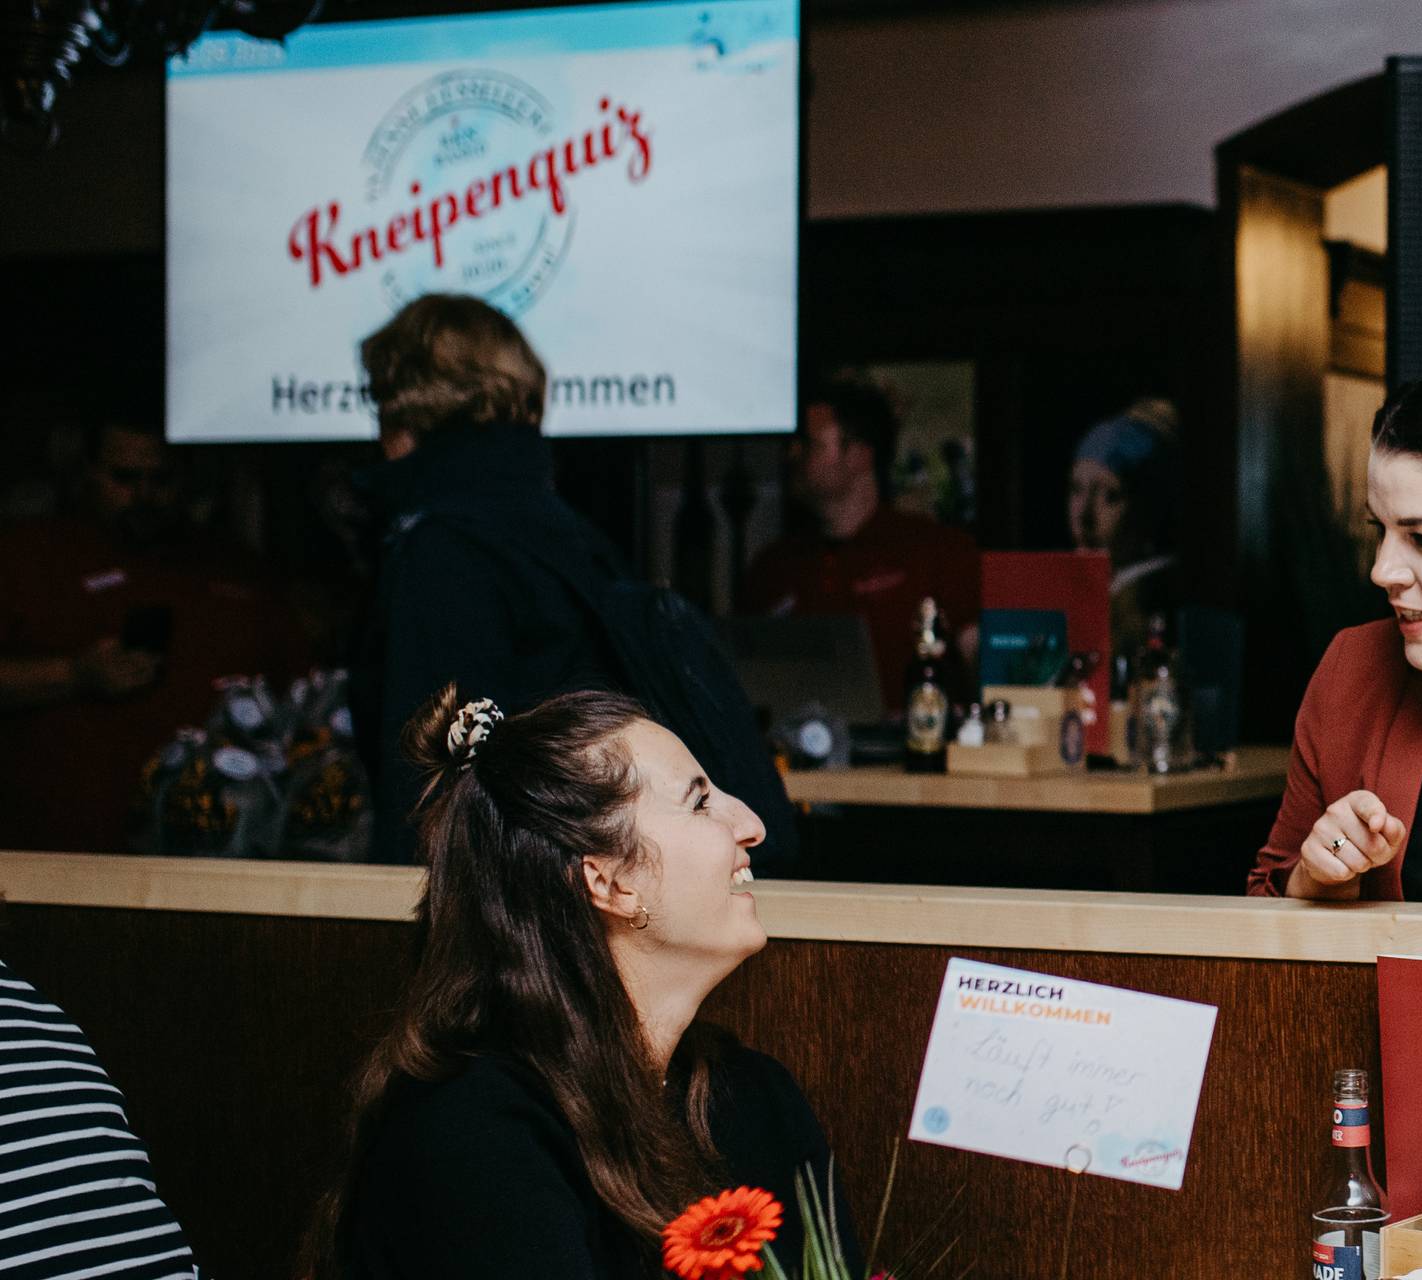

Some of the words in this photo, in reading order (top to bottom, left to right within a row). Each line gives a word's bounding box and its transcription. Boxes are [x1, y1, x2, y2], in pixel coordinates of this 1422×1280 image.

[288, 97, 655, 289] Kneipenquiz
[957, 975, 1064, 1001] HERZLICH
[959, 992, 1112, 1026] WILLKOMMEN
